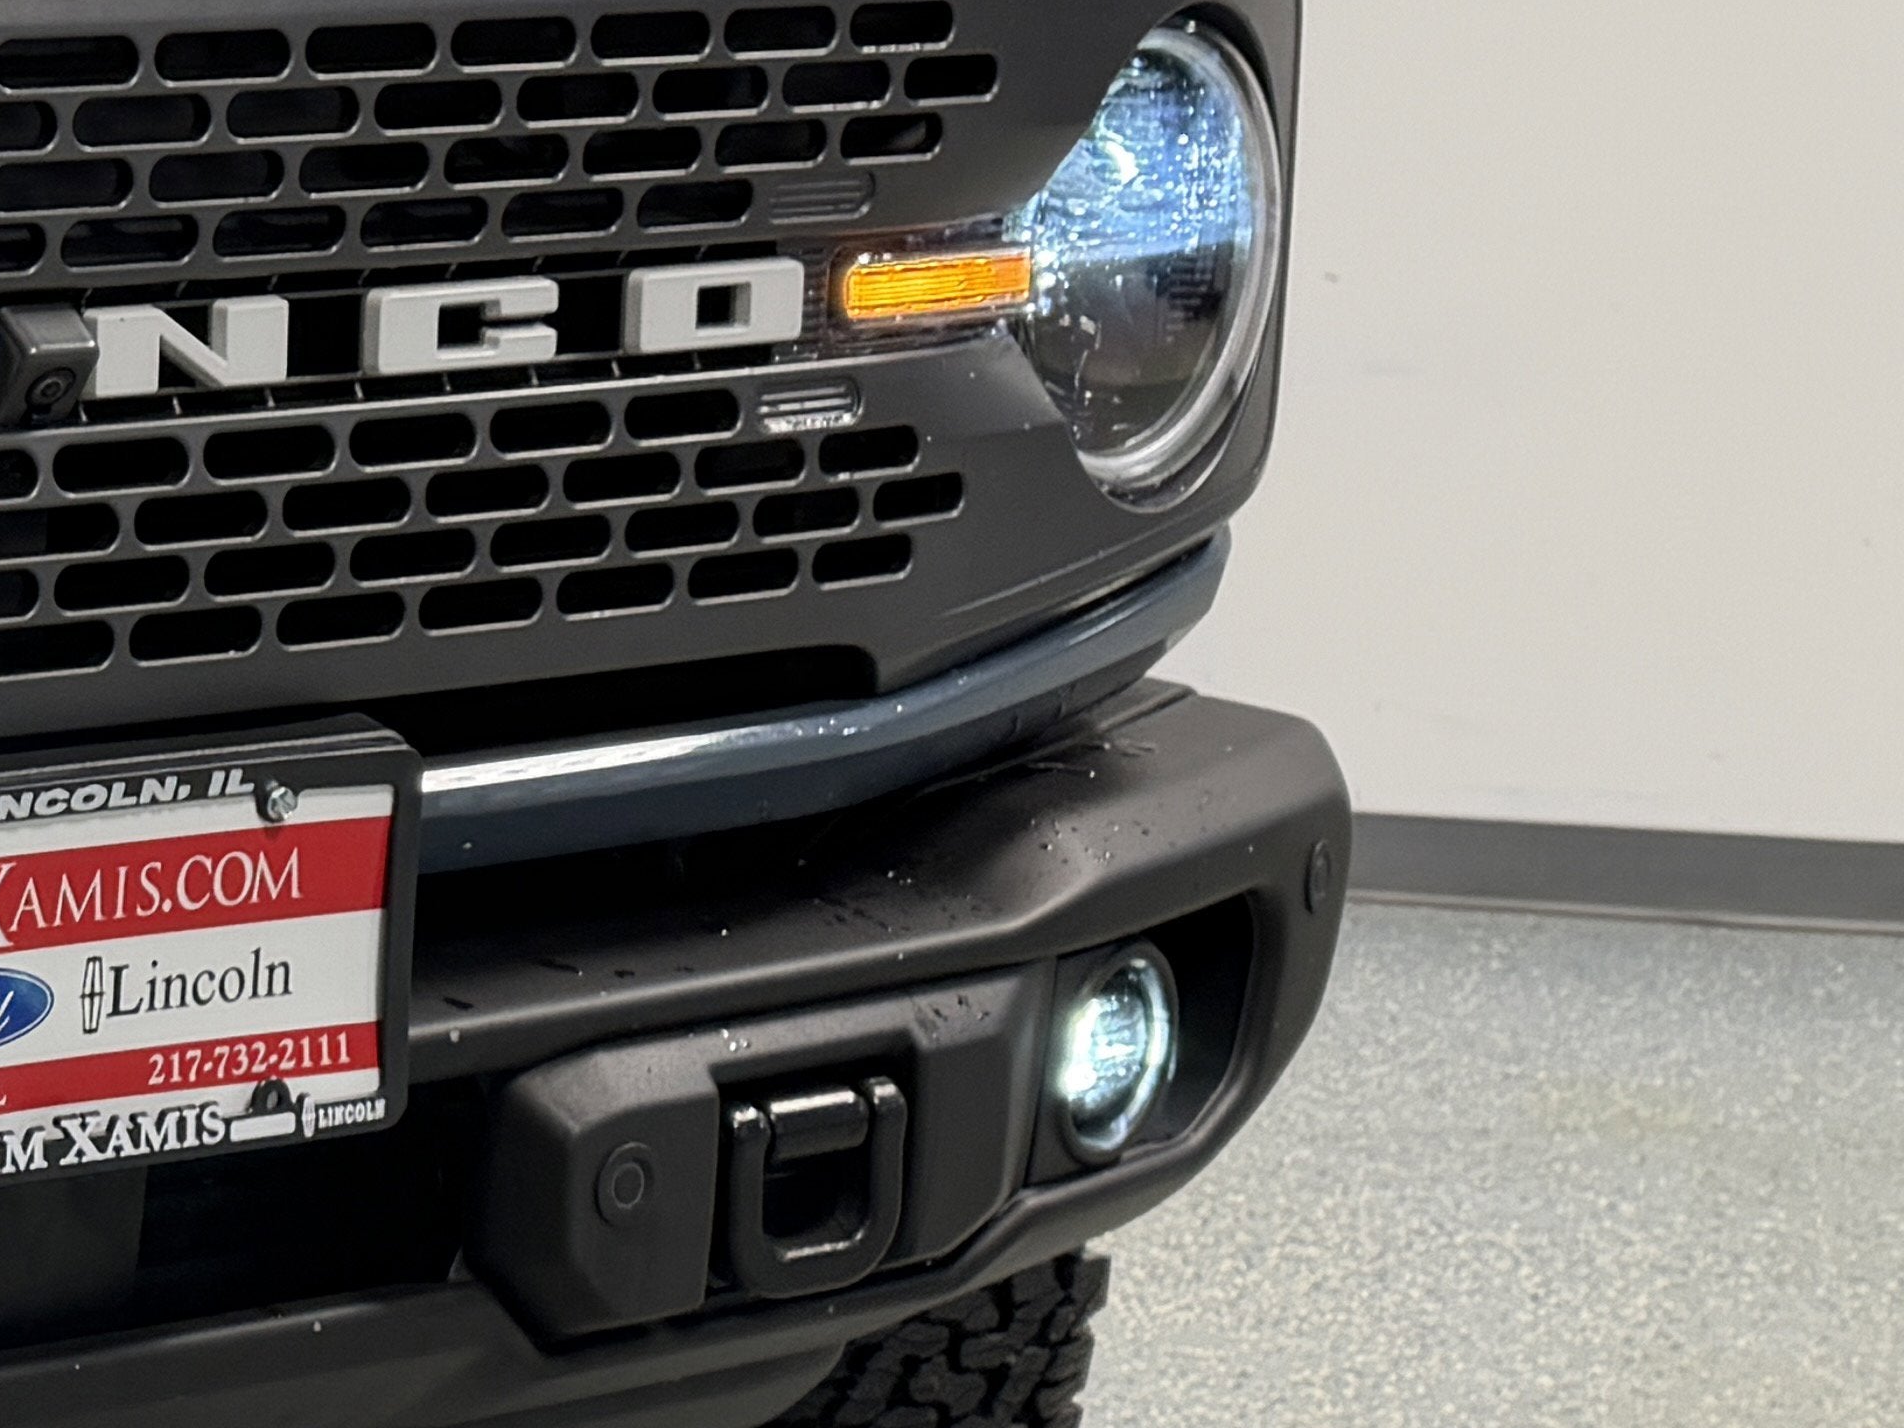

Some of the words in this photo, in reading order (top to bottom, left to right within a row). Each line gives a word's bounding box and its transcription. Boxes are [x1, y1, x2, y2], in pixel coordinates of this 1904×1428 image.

[207, 768, 255, 797] IL
[106, 947, 293, 1020] Lincoln
[148, 1031, 351, 1086] 217-732-2111
[56, 1105, 227, 1165] XAMIS
[317, 1097, 387, 1130] LINCOLN
